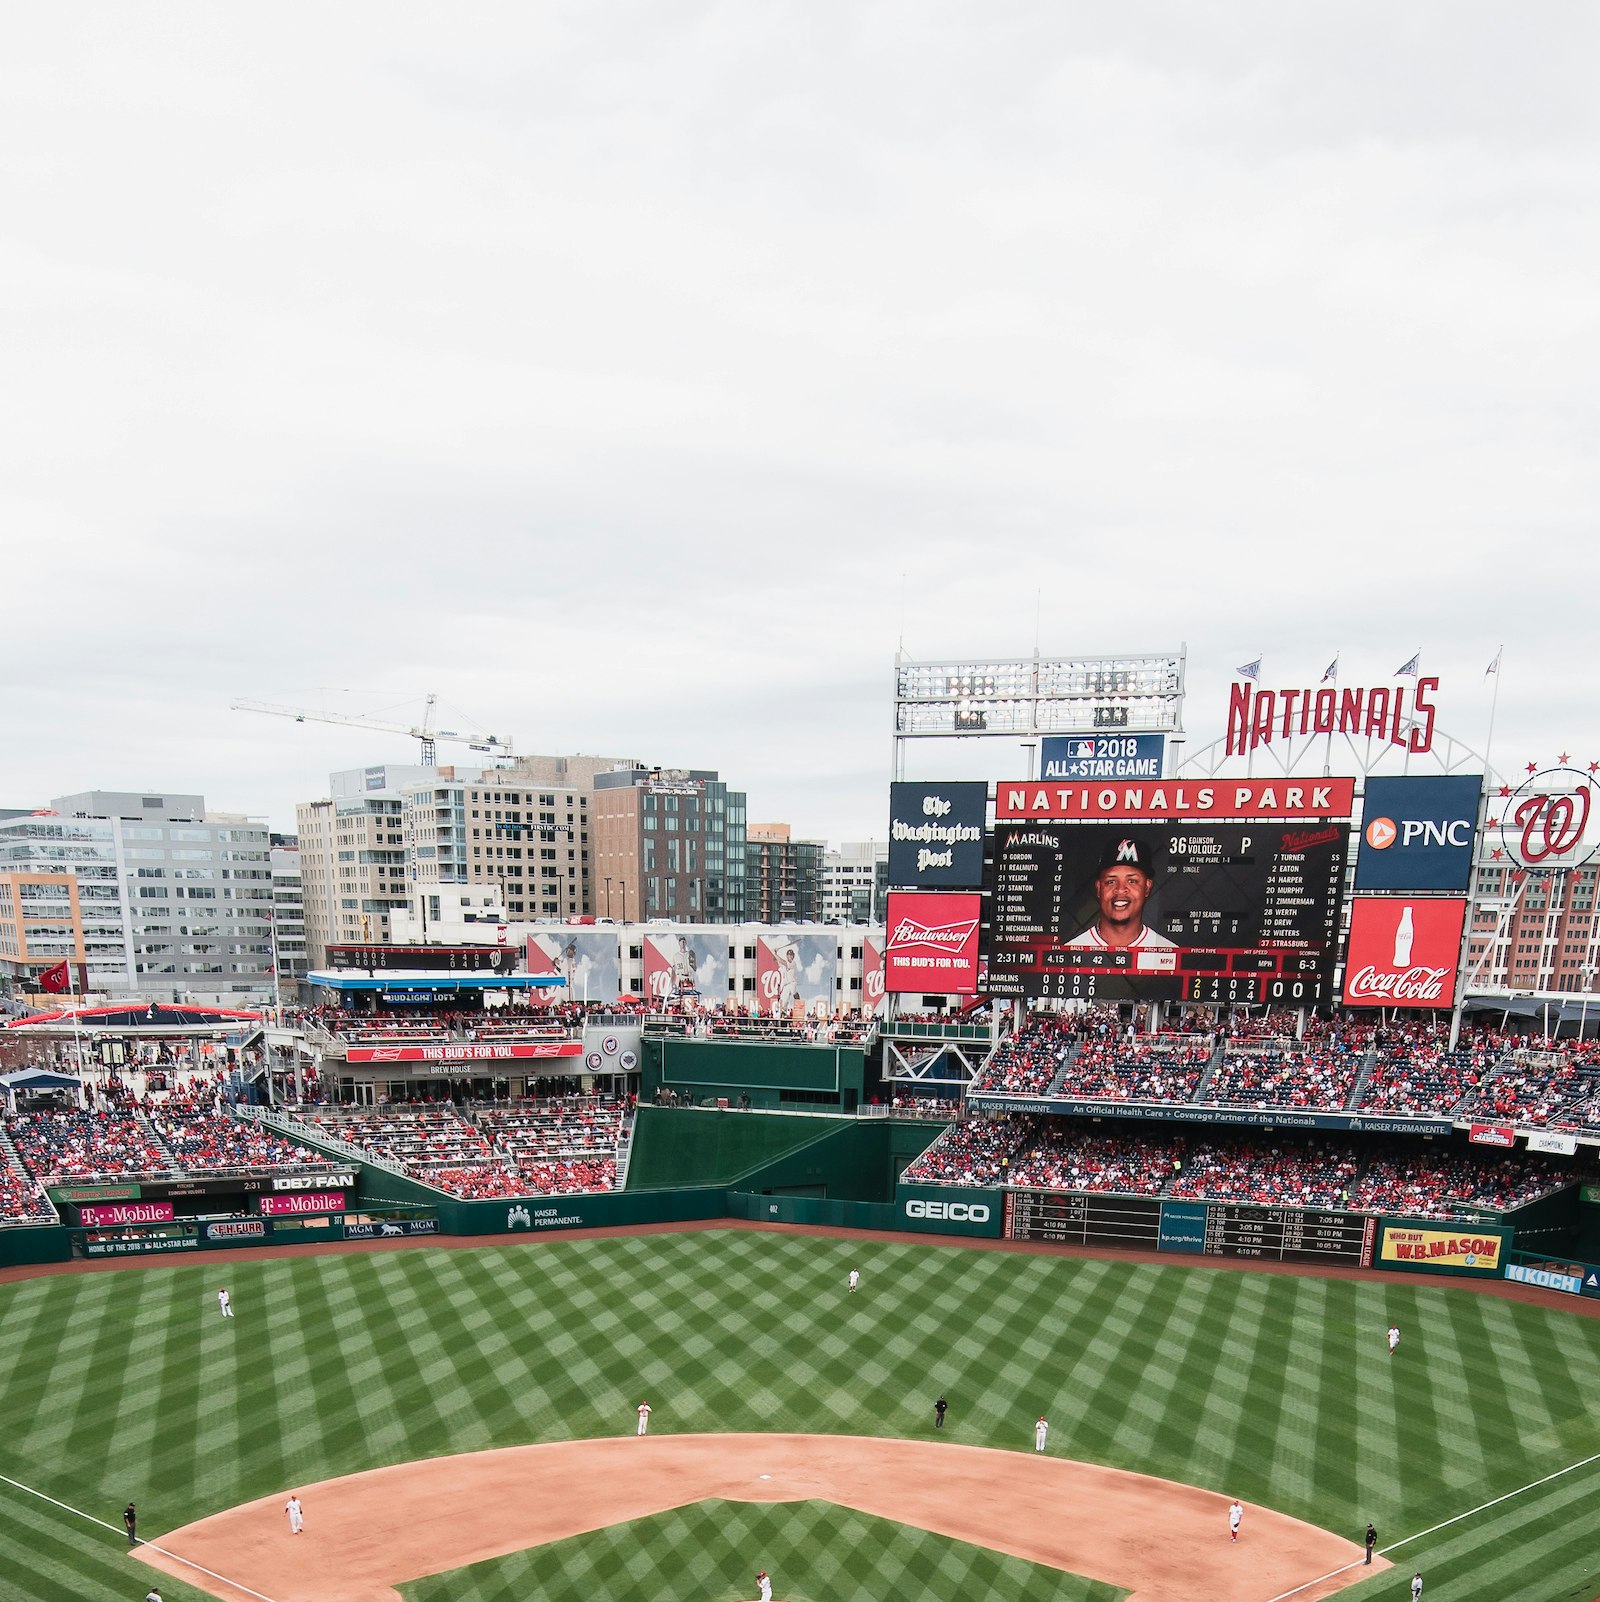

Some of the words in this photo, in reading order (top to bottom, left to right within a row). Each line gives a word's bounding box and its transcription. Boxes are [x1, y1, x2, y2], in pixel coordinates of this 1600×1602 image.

[1225, 677, 1439, 756] NATIONALS
[1097, 738, 1137, 758] 2018
[1045, 760, 1069, 777] ALL
[1079, 759, 1115, 776] STAR
[1116, 758, 1158, 776] GAME
[1008, 788, 1214, 811] NATIONALS
[1235, 786, 1333, 809] PARK
[922, 795, 951, 818] The
[892, 818, 981, 844] Washington
[1514, 785, 1590, 863] W
[1280, 824, 1340, 853] Nationals
[1402, 819, 1471, 847] PNC
[1004, 831, 1060, 850] MARLINS
[1169, 836, 1187, 854] 36
[1240, 836, 1252, 855] P
[1187, 844, 1223, 854] VOLQUEZ
[917, 848, 953, 873] Post
[1279, 865, 1299, 873] EATON
[1278, 876, 1303, 884] HARPER
[894, 925, 969, 942] Budweiser
[1272, 940, 1309, 948] STRASBURG
[893, 956, 911, 967] THIS
[912, 957, 935, 968] BUD'S
[935, 958, 952, 968] FOR
[952, 958, 971, 968] YOU.
[996, 953, 1017, 963] 2:31
[1019, 953, 1034, 964] PM
[1047, 955, 1065, 964] 4.15
[1299, 960, 1316, 970] 6-3
[990, 974, 1019, 982] MARLINS
[1348, 965, 1451, 1000] Coca-Cola
[989, 985, 1025, 993] NATIONALS
[422, 1048, 443, 1059] THIS
[445, 1047, 473, 1059] BUD'S
[474, 1047, 492, 1058] FOR
[493, 1046, 515, 1057] YOU.
[430, 1065, 449, 1074] BREW
[450, 1065, 471, 1073] HOUSE
[981, 1101, 1008, 1111] KAISER
[1009, 1102, 1052, 1113] PERMANENTE
[1072, 1105, 1084, 1113] An
[1086, 1105, 1115, 1115] Official
[1116, 1106, 1143, 1116] Health
[1144, 1108, 1164, 1118] Care
[1173, 1110, 1213, 1122] Coverage
[1214, 1112, 1245, 1123] Partner
[1247, 1113, 1257, 1123] of
[1258, 1114, 1273, 1123] the
[1275, 1114, 1316, 1126] Nationals
[1365, 1121, 1391, 1132] KAISER
[1392, 1123, 1446, 1134] PERMANENTE
[316, 1175, 354, 1188] FAN
[534, 1209, 557, 1218] KAISER
[905, 1199, 990, 1223] GEICO
[349, 1224, 373, 1235] MGM
[410, 1220, 434, 1231] MGM
[534, 1216, 581, 1226] PERMANENTE
[1161, 1234, 1203, 1243] kp.org/thrive
[1389, 1232, 1407, 1241] WHO
[1407, 1233, 1424, 1242] BUT
[88, 1245, 106, 1253] HOME
[106, 1244, 115, 1252] OF
[127, 1243, 141, 1251] 2018
[152, 1241, 163, 1249] ALL
[167, 1240, 182, 1248] STAR
[182, 1239, 198, 1247] GAME
[1396, 1238, 1498, 1260] W.B.MASON
